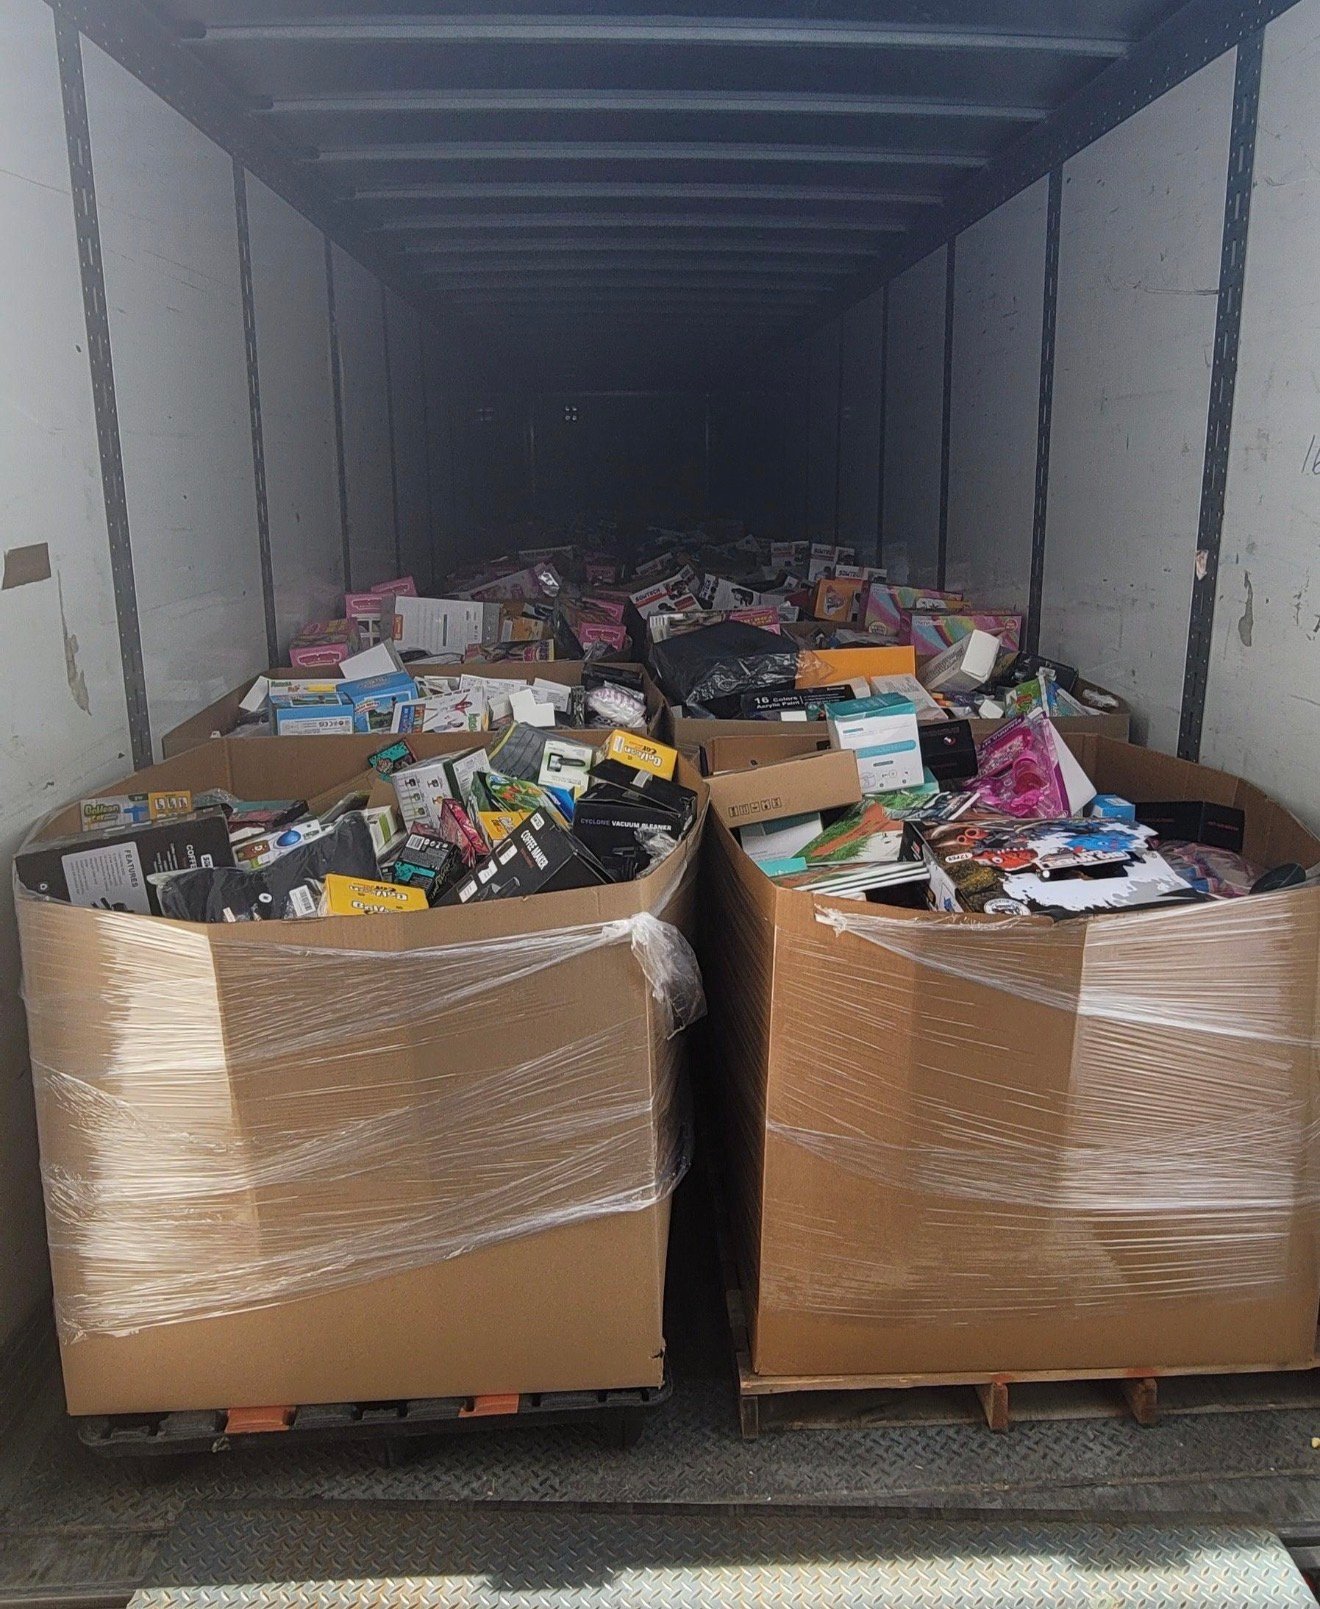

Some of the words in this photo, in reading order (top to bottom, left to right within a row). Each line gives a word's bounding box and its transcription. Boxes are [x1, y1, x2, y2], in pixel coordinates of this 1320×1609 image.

[611, 820, 640, 829] VACUUM
[186, 845, 197, 869] COFFE
[520, 829, 537, 854] COFFEE
[532, 848, 549, 871] MAKER
[124, 849, 138, 888] FEATURES
